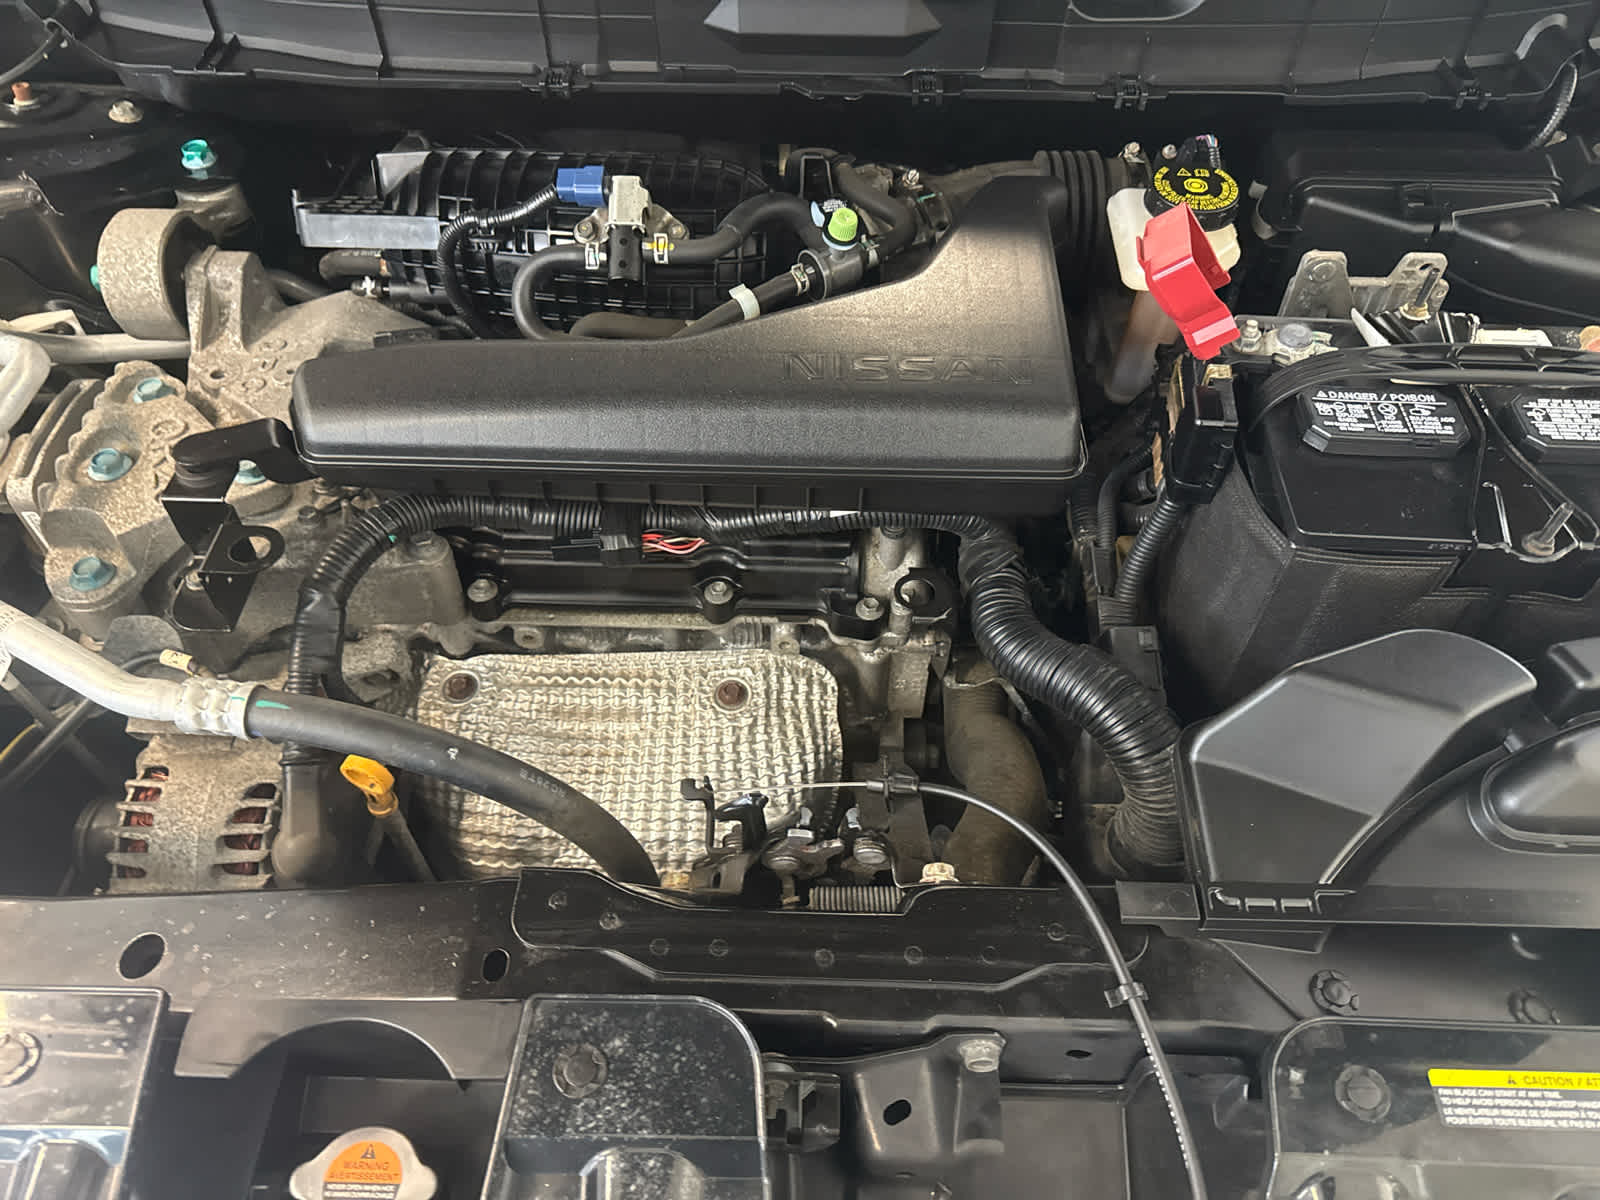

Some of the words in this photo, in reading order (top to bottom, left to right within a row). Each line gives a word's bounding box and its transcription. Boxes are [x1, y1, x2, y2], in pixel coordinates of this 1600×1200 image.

[784, 353, 1033, 385] NISSAN
[1328, 391, 1378, 401] DANGER
[1390, 393, 1436, 402] POISON
[1523, 1075, 1574, 1086] CAUTION
